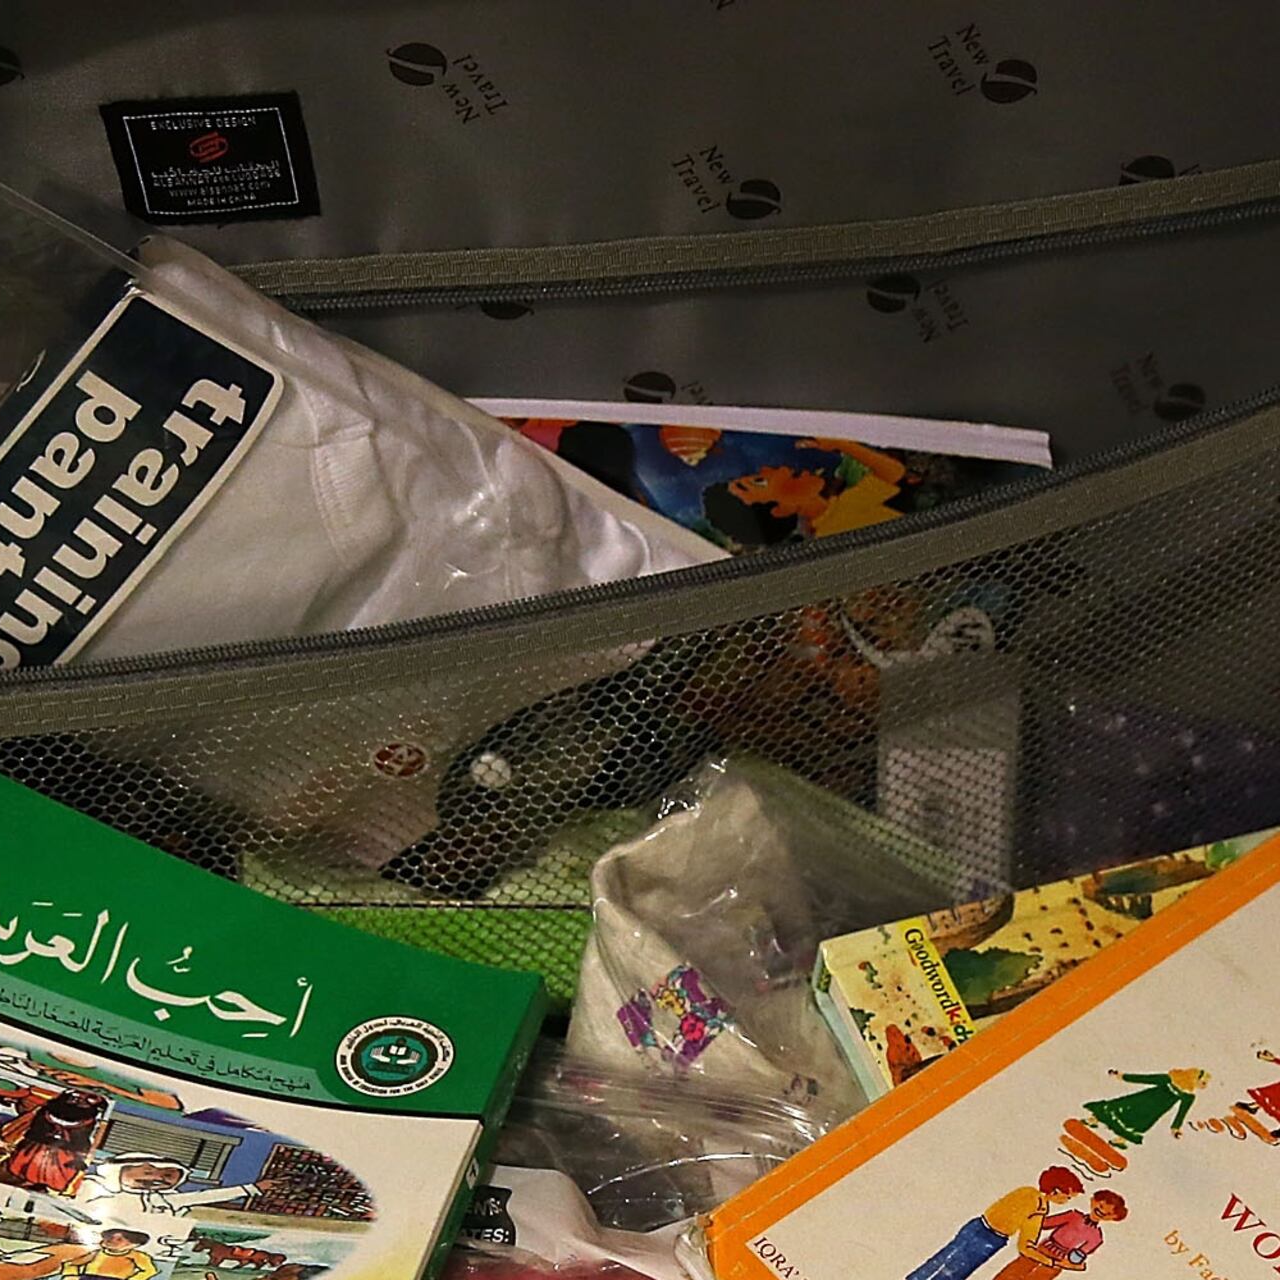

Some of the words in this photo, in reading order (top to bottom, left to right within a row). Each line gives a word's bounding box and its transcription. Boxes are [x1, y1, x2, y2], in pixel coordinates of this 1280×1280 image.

[928, 35, 972, 96] Travel
[956, 23, 989, 66] New
[442, 82, 480, 124] New
[452, 53, 508, 115] Travel
[150, 117, 212, 131] EXCLUSIVE
[216, 115, 257, 128] DESIGN
[672, 154, 720, 214] Travel
[699, 145, 733, 186] New
[1163, 1229, 1191, 1256] by
